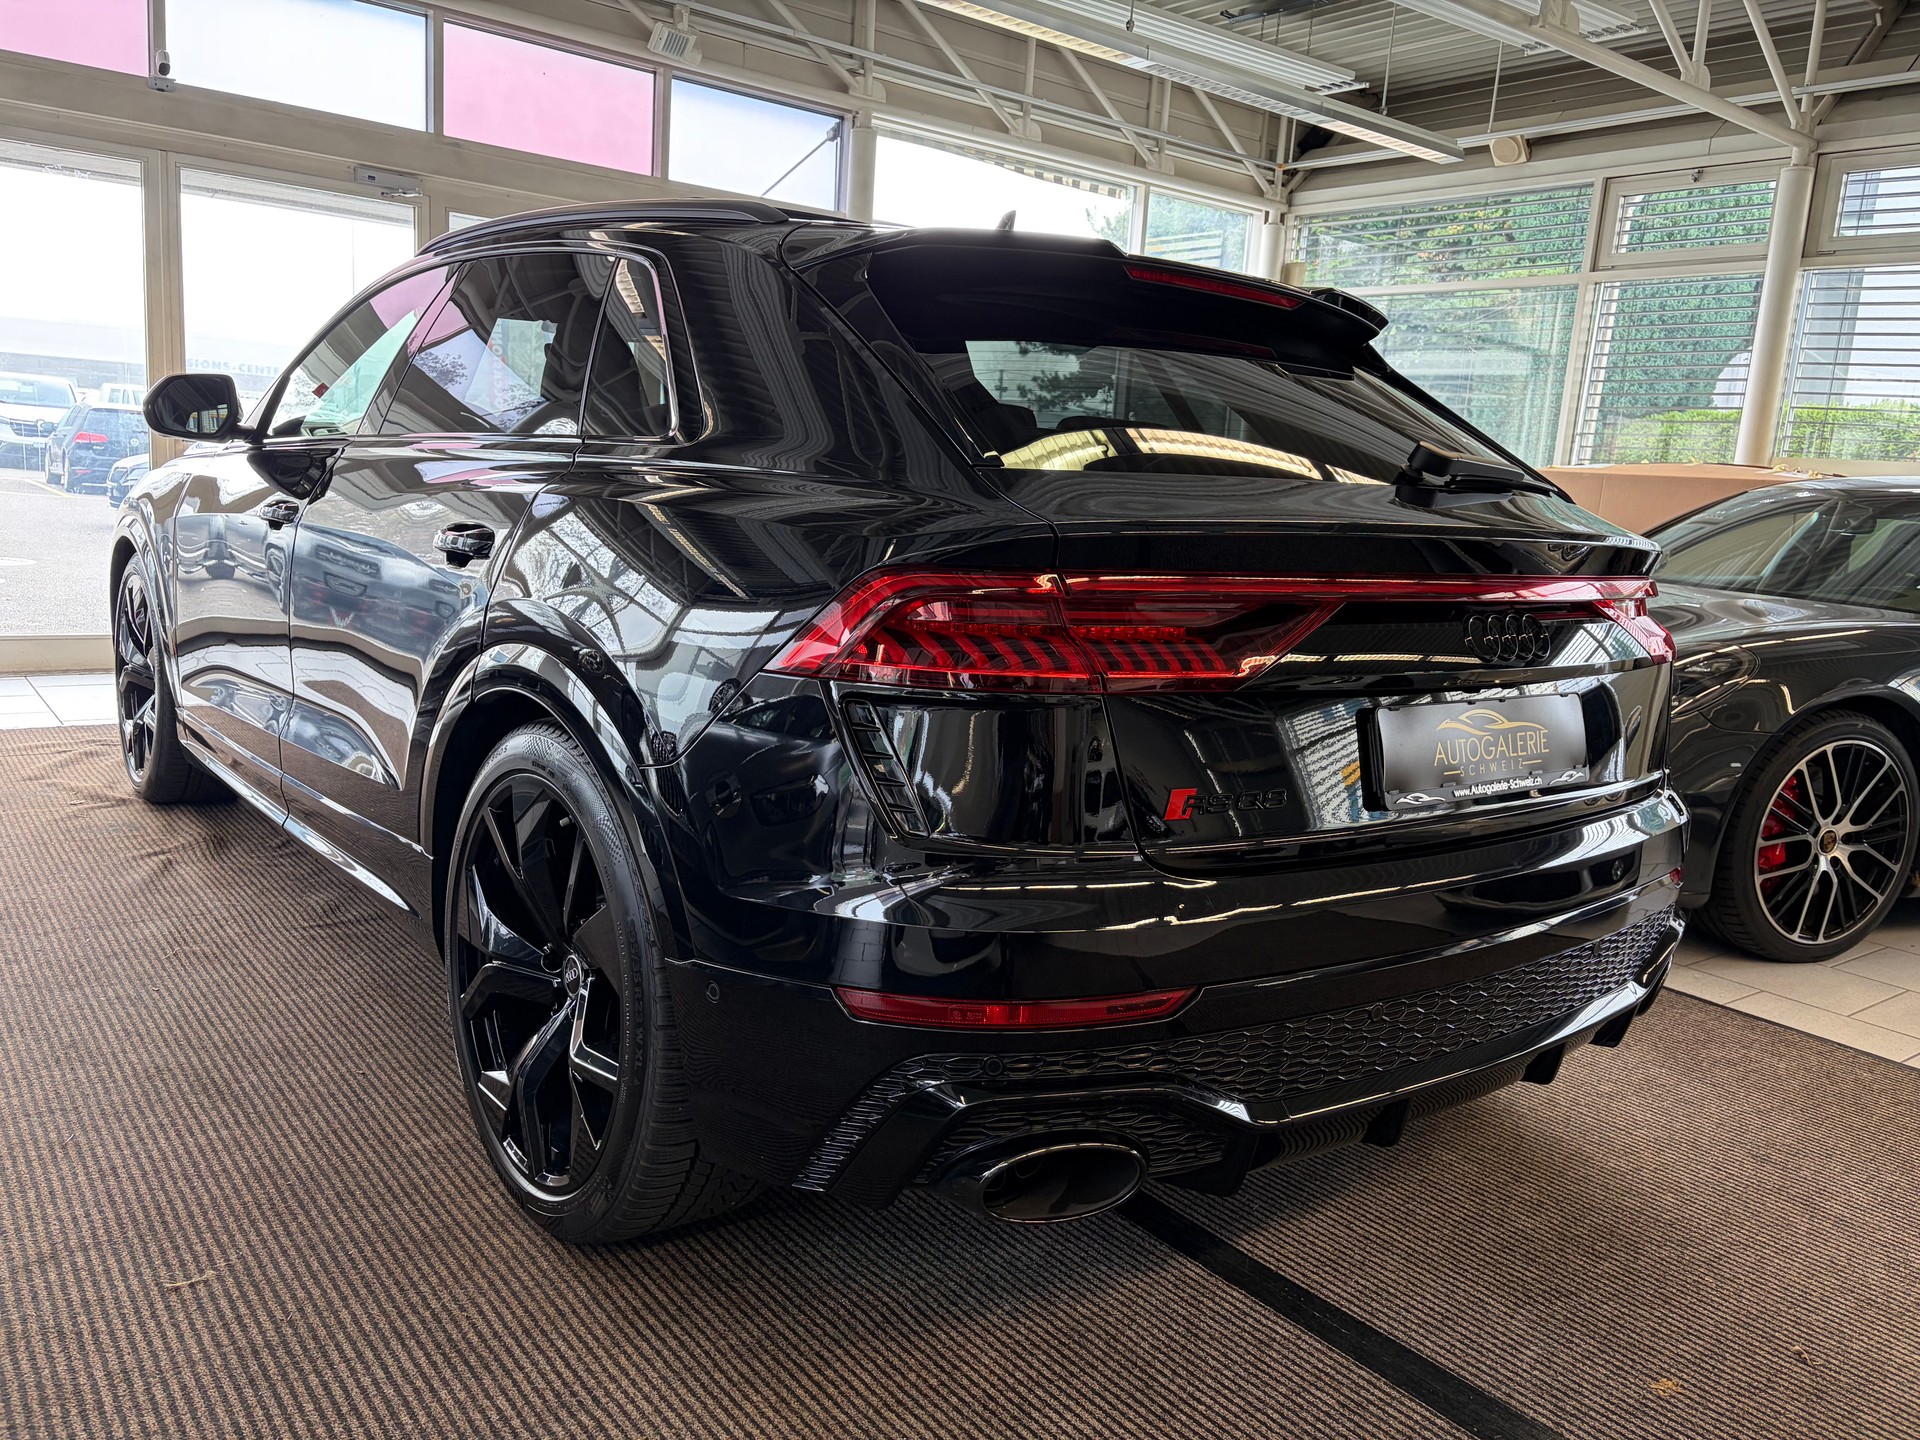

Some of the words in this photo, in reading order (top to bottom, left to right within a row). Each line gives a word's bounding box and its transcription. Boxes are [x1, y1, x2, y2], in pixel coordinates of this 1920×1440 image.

[1434, 729, 1549, 766] AUTOGALERIE
[1460, 758, 1523, 777] SCHWEIZ
[1453, 775, 1543, 798] www.Autogalerie-Schweiz.ch
